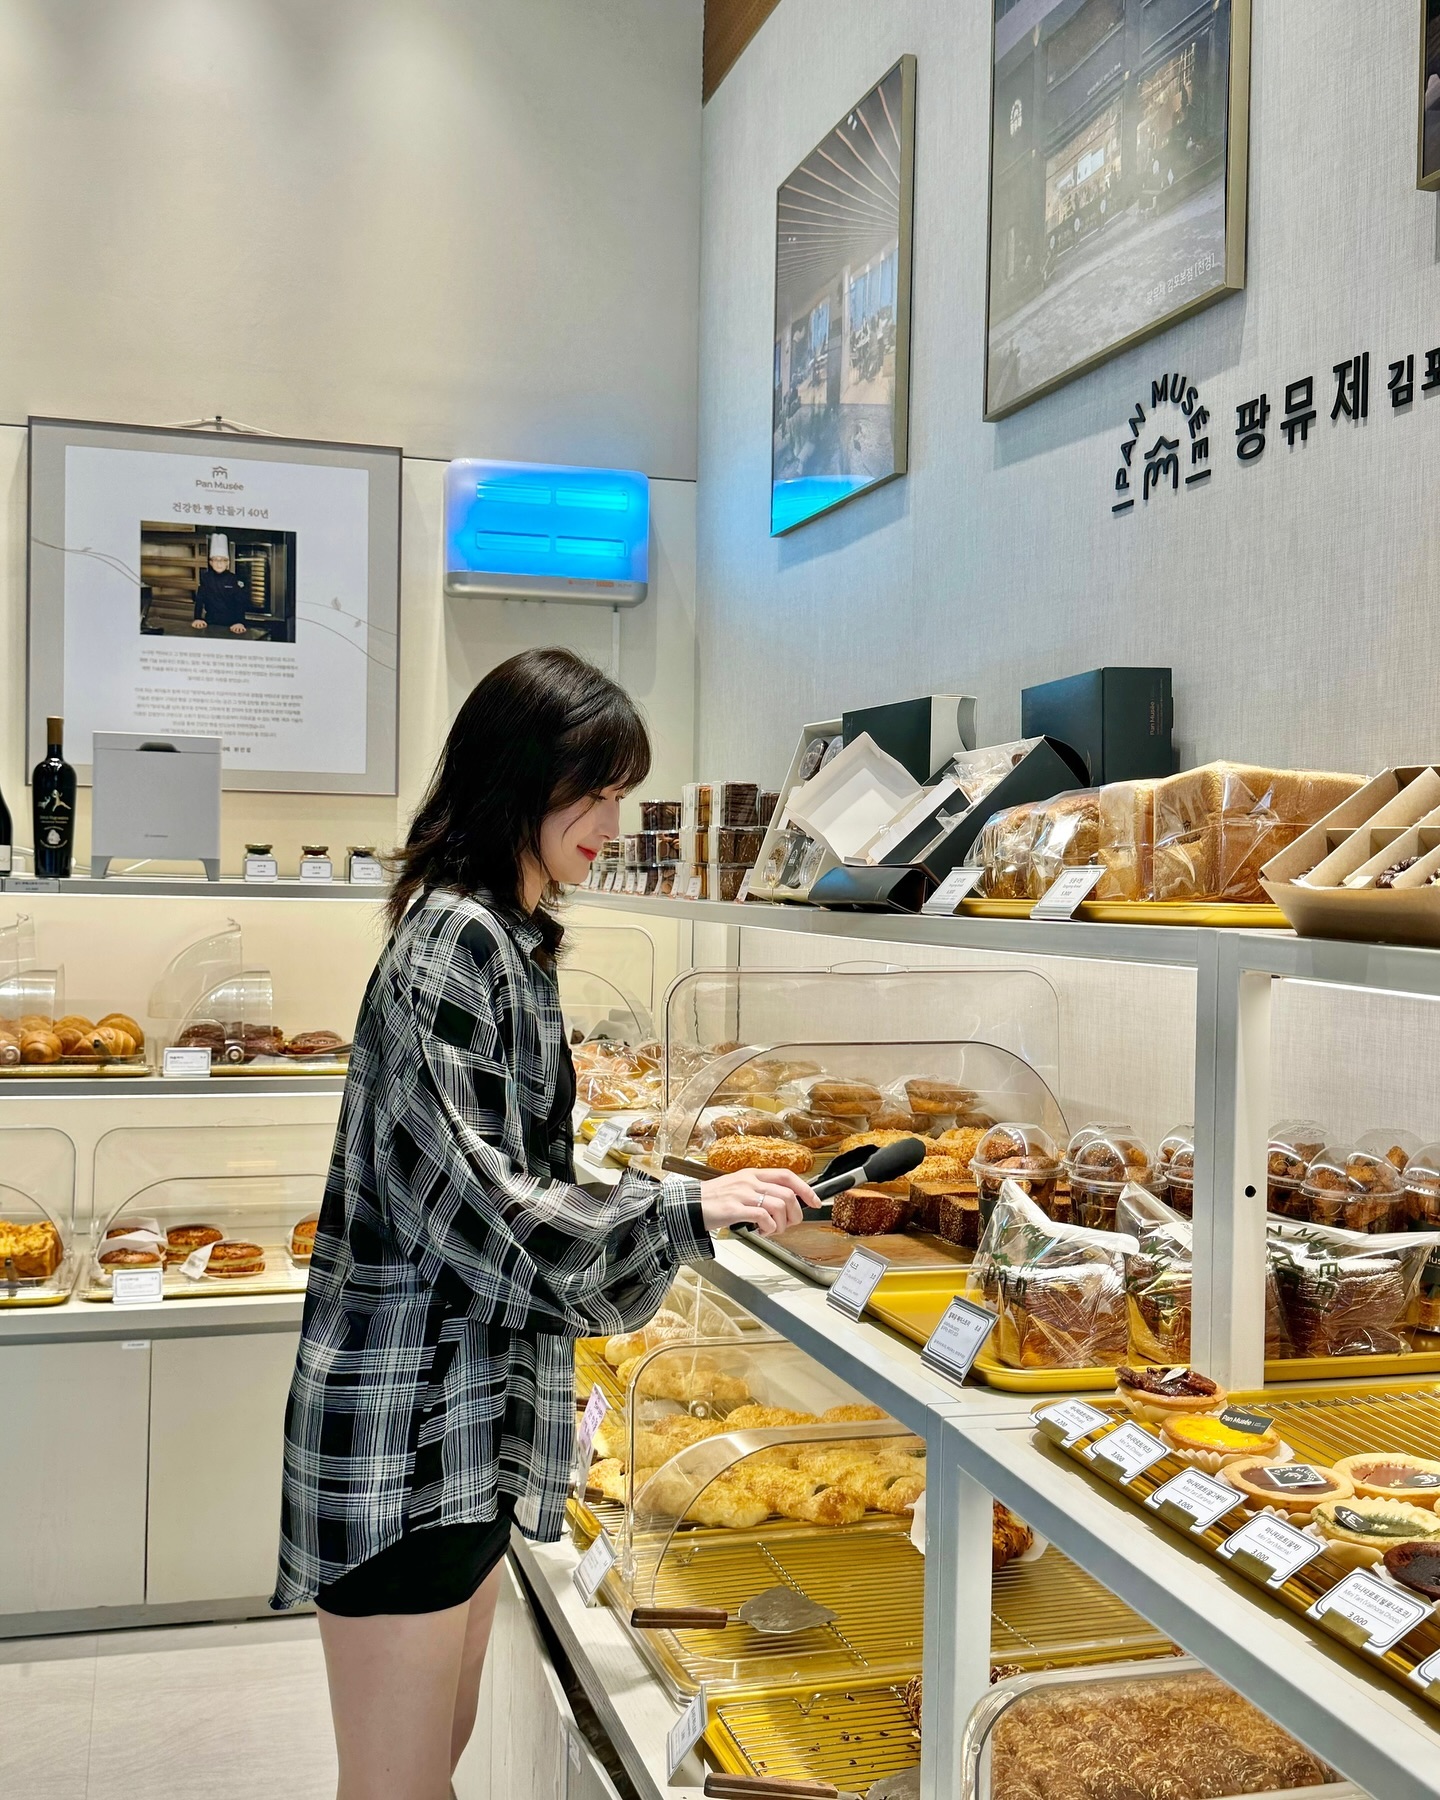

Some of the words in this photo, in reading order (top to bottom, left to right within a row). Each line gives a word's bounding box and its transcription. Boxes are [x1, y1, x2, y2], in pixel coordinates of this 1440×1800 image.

[1235, 352, 1369, 460] 팡뮤제
[1115, 403, 1146, 490] PAN
[195, 479, 213, 488] Pan
[214, 480, 244, 491] Musée
[172, 502, 202, 514] 건강한
[204, 504, 214, 515] 빵
[216, 505, 245, 517] 만들기
[247, 507, 269, 519] 40년
[1221, 1414, 1233, 1422] Pan
[1343, 1588, 1355, 1598] Mini
